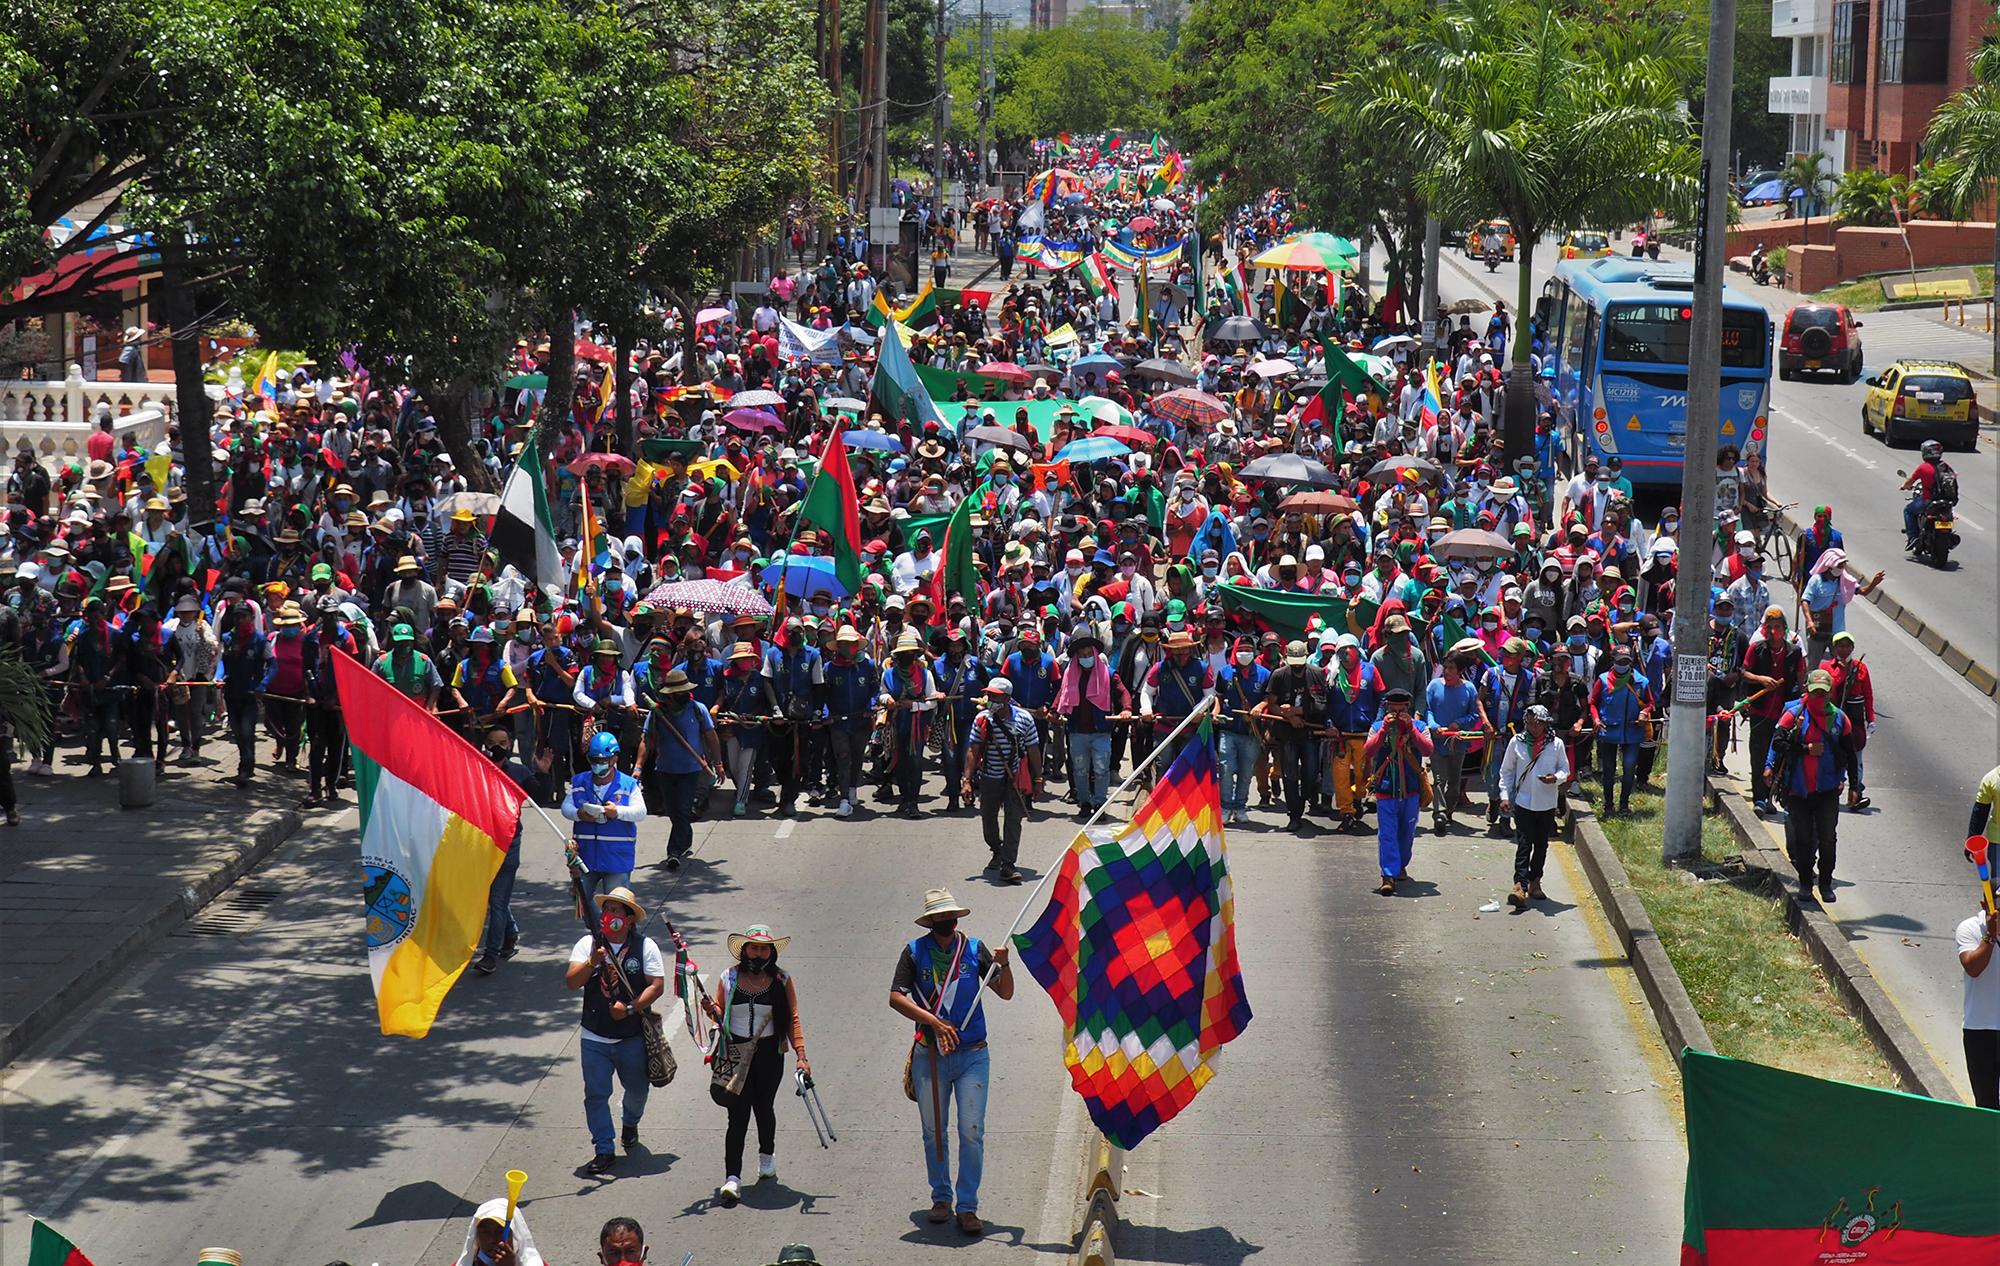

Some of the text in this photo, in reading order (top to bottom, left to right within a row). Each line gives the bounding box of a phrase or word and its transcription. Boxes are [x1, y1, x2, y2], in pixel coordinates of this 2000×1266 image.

[1606, 388, 1639, 397] MC12135
[1653, 395, 1688, 407] m
[395, 907, 418, 945] ORIVAC
